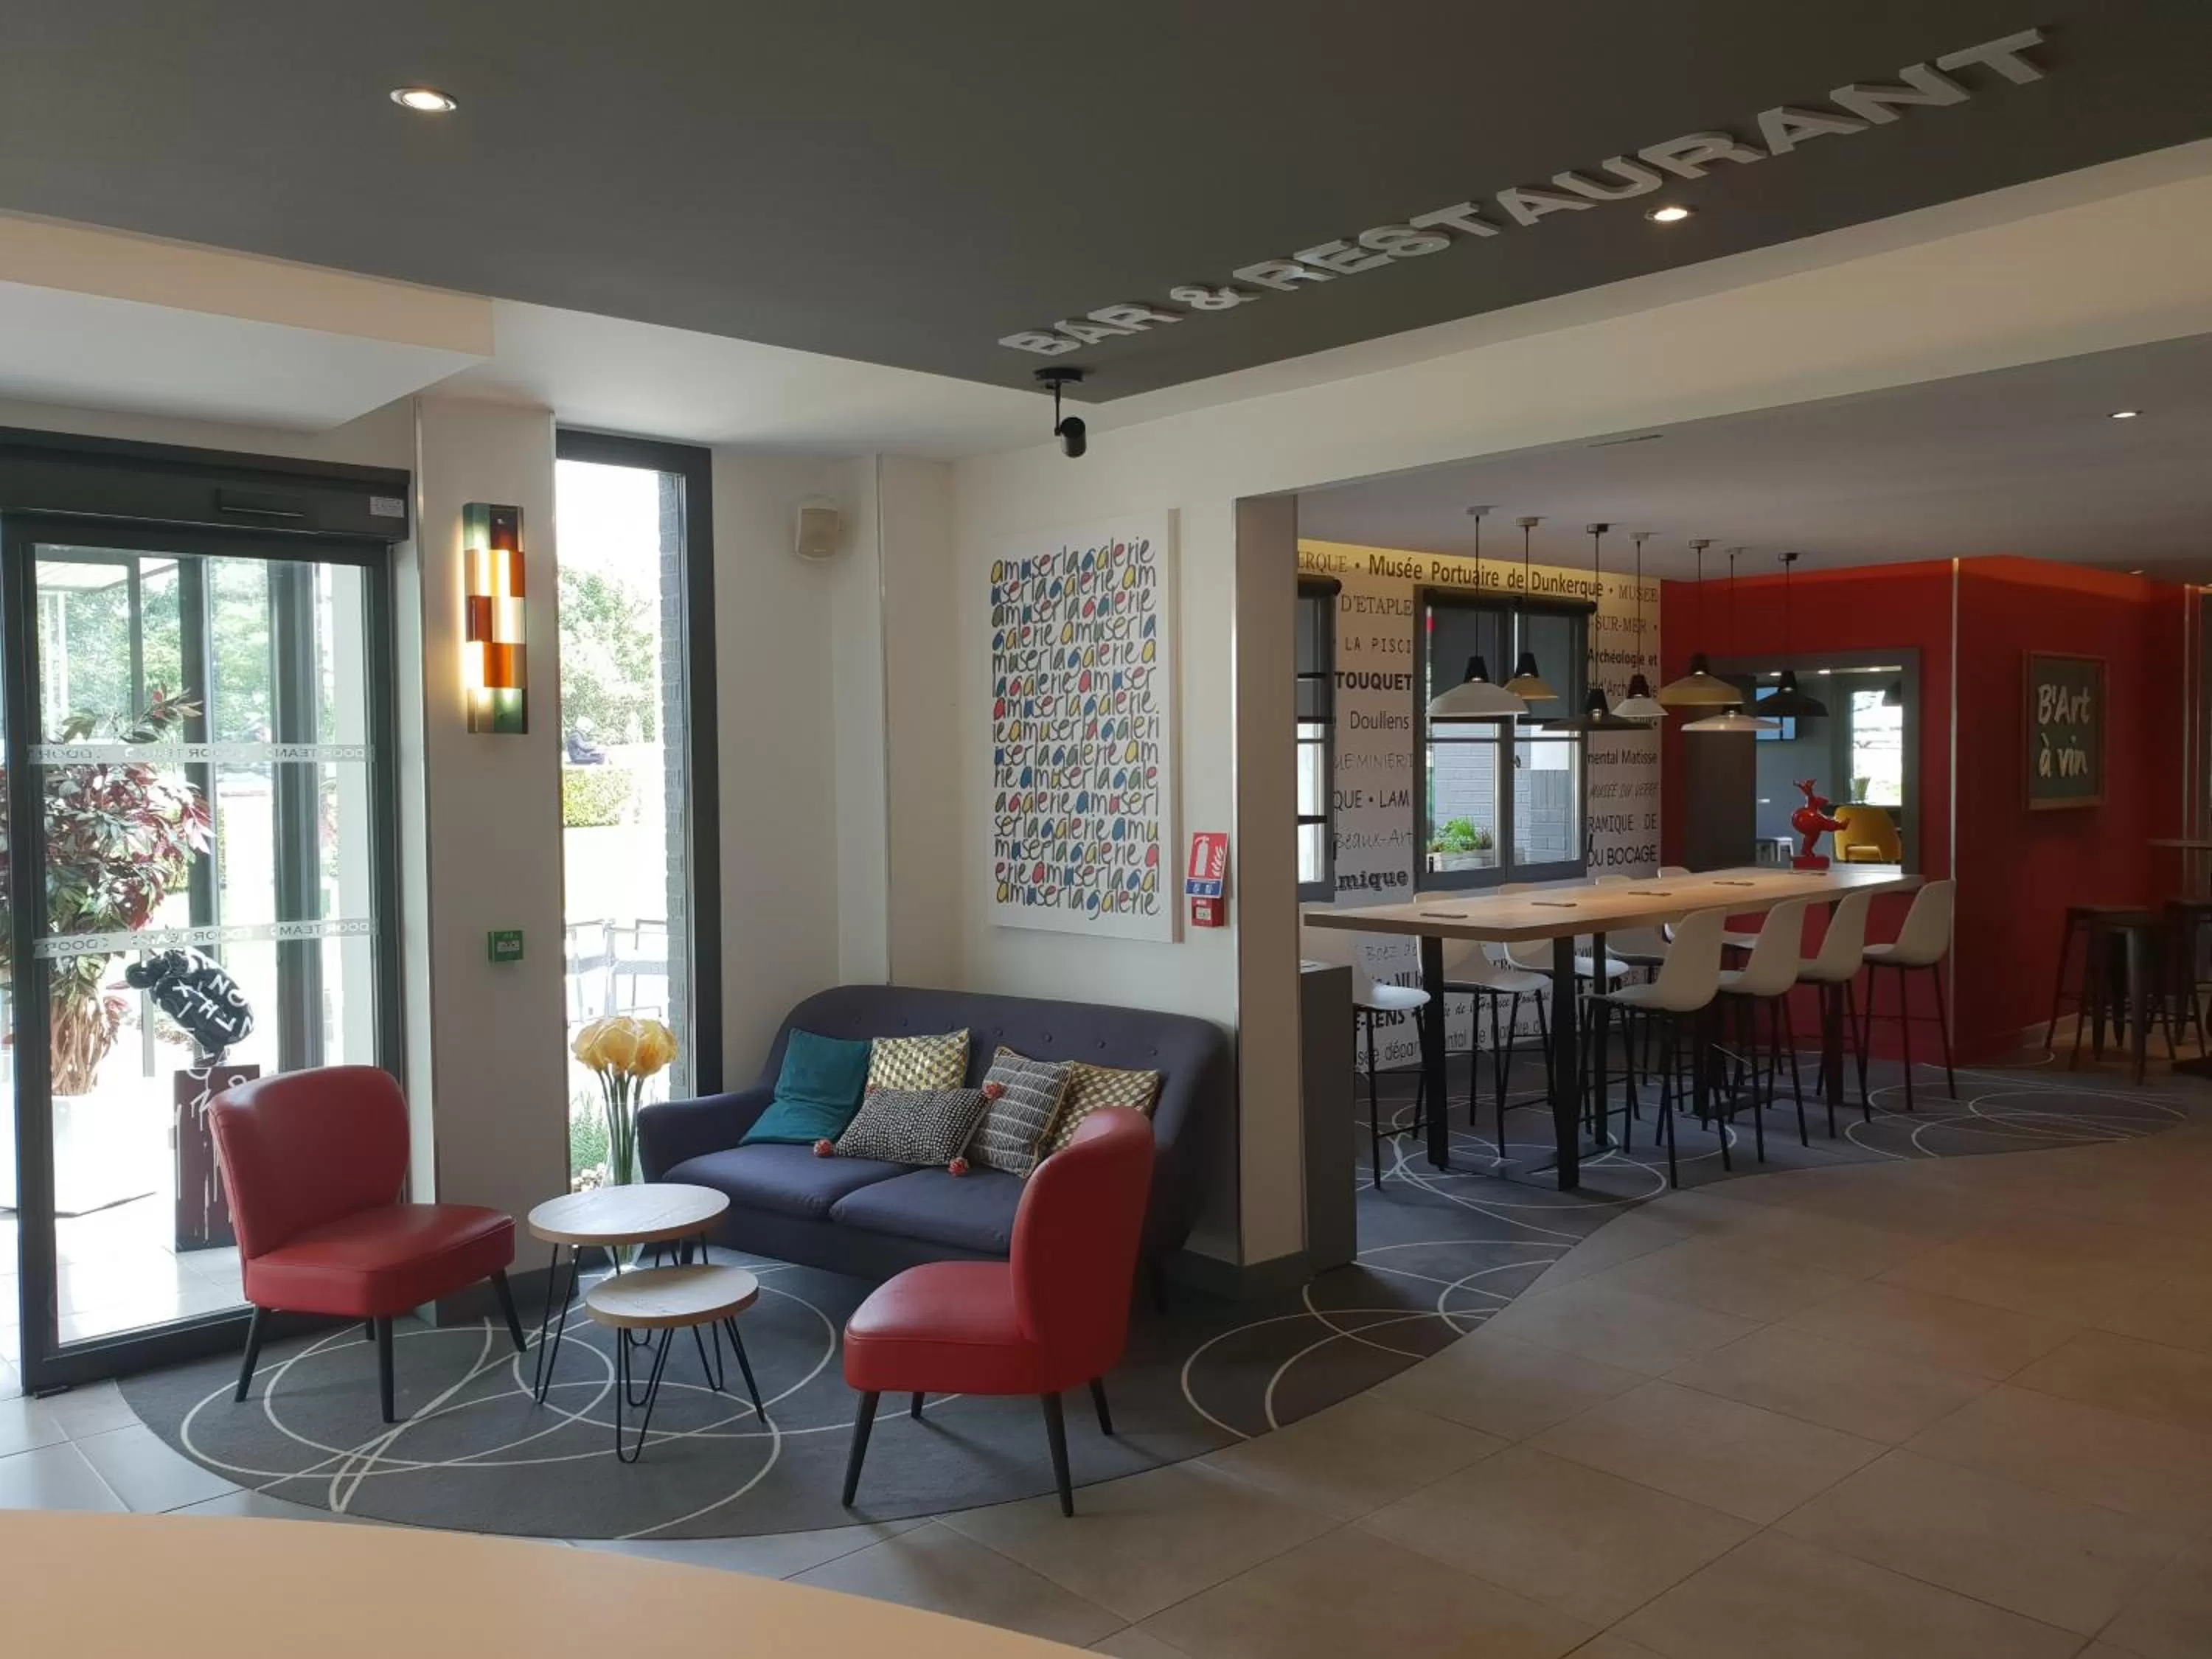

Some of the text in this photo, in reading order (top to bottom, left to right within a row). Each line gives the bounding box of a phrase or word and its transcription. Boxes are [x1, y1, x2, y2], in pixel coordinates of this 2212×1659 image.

[998, 28, 2048, 357] BAR & RESTAURANT
[1369, 554, 1422, 580] Musée
[1431, 560, 1499, 588] Portuaire
[1507, 567, 1524, 588] de
[1532, 571, 1603, 597] Dunkerque
[1345, 636, 1361, 652] LA
[1649, 654, 1658, 667] et
[1334, 671, 1413, 691] TOUQUET
[2037, 684, 2092, 726] B'Art
[1350, 710, 1409, 730] Doullens
[1622, 748, 1658, 765] Matisse
[2039, 732, 2088, 778] à vin
[1333, 790, 1409, 812] QUE LAM
[1644, 813, 1658, 830] DE
[1607, 845, 1658, 866] BOCAGE
[1335, 869, 1408, 891] mique
